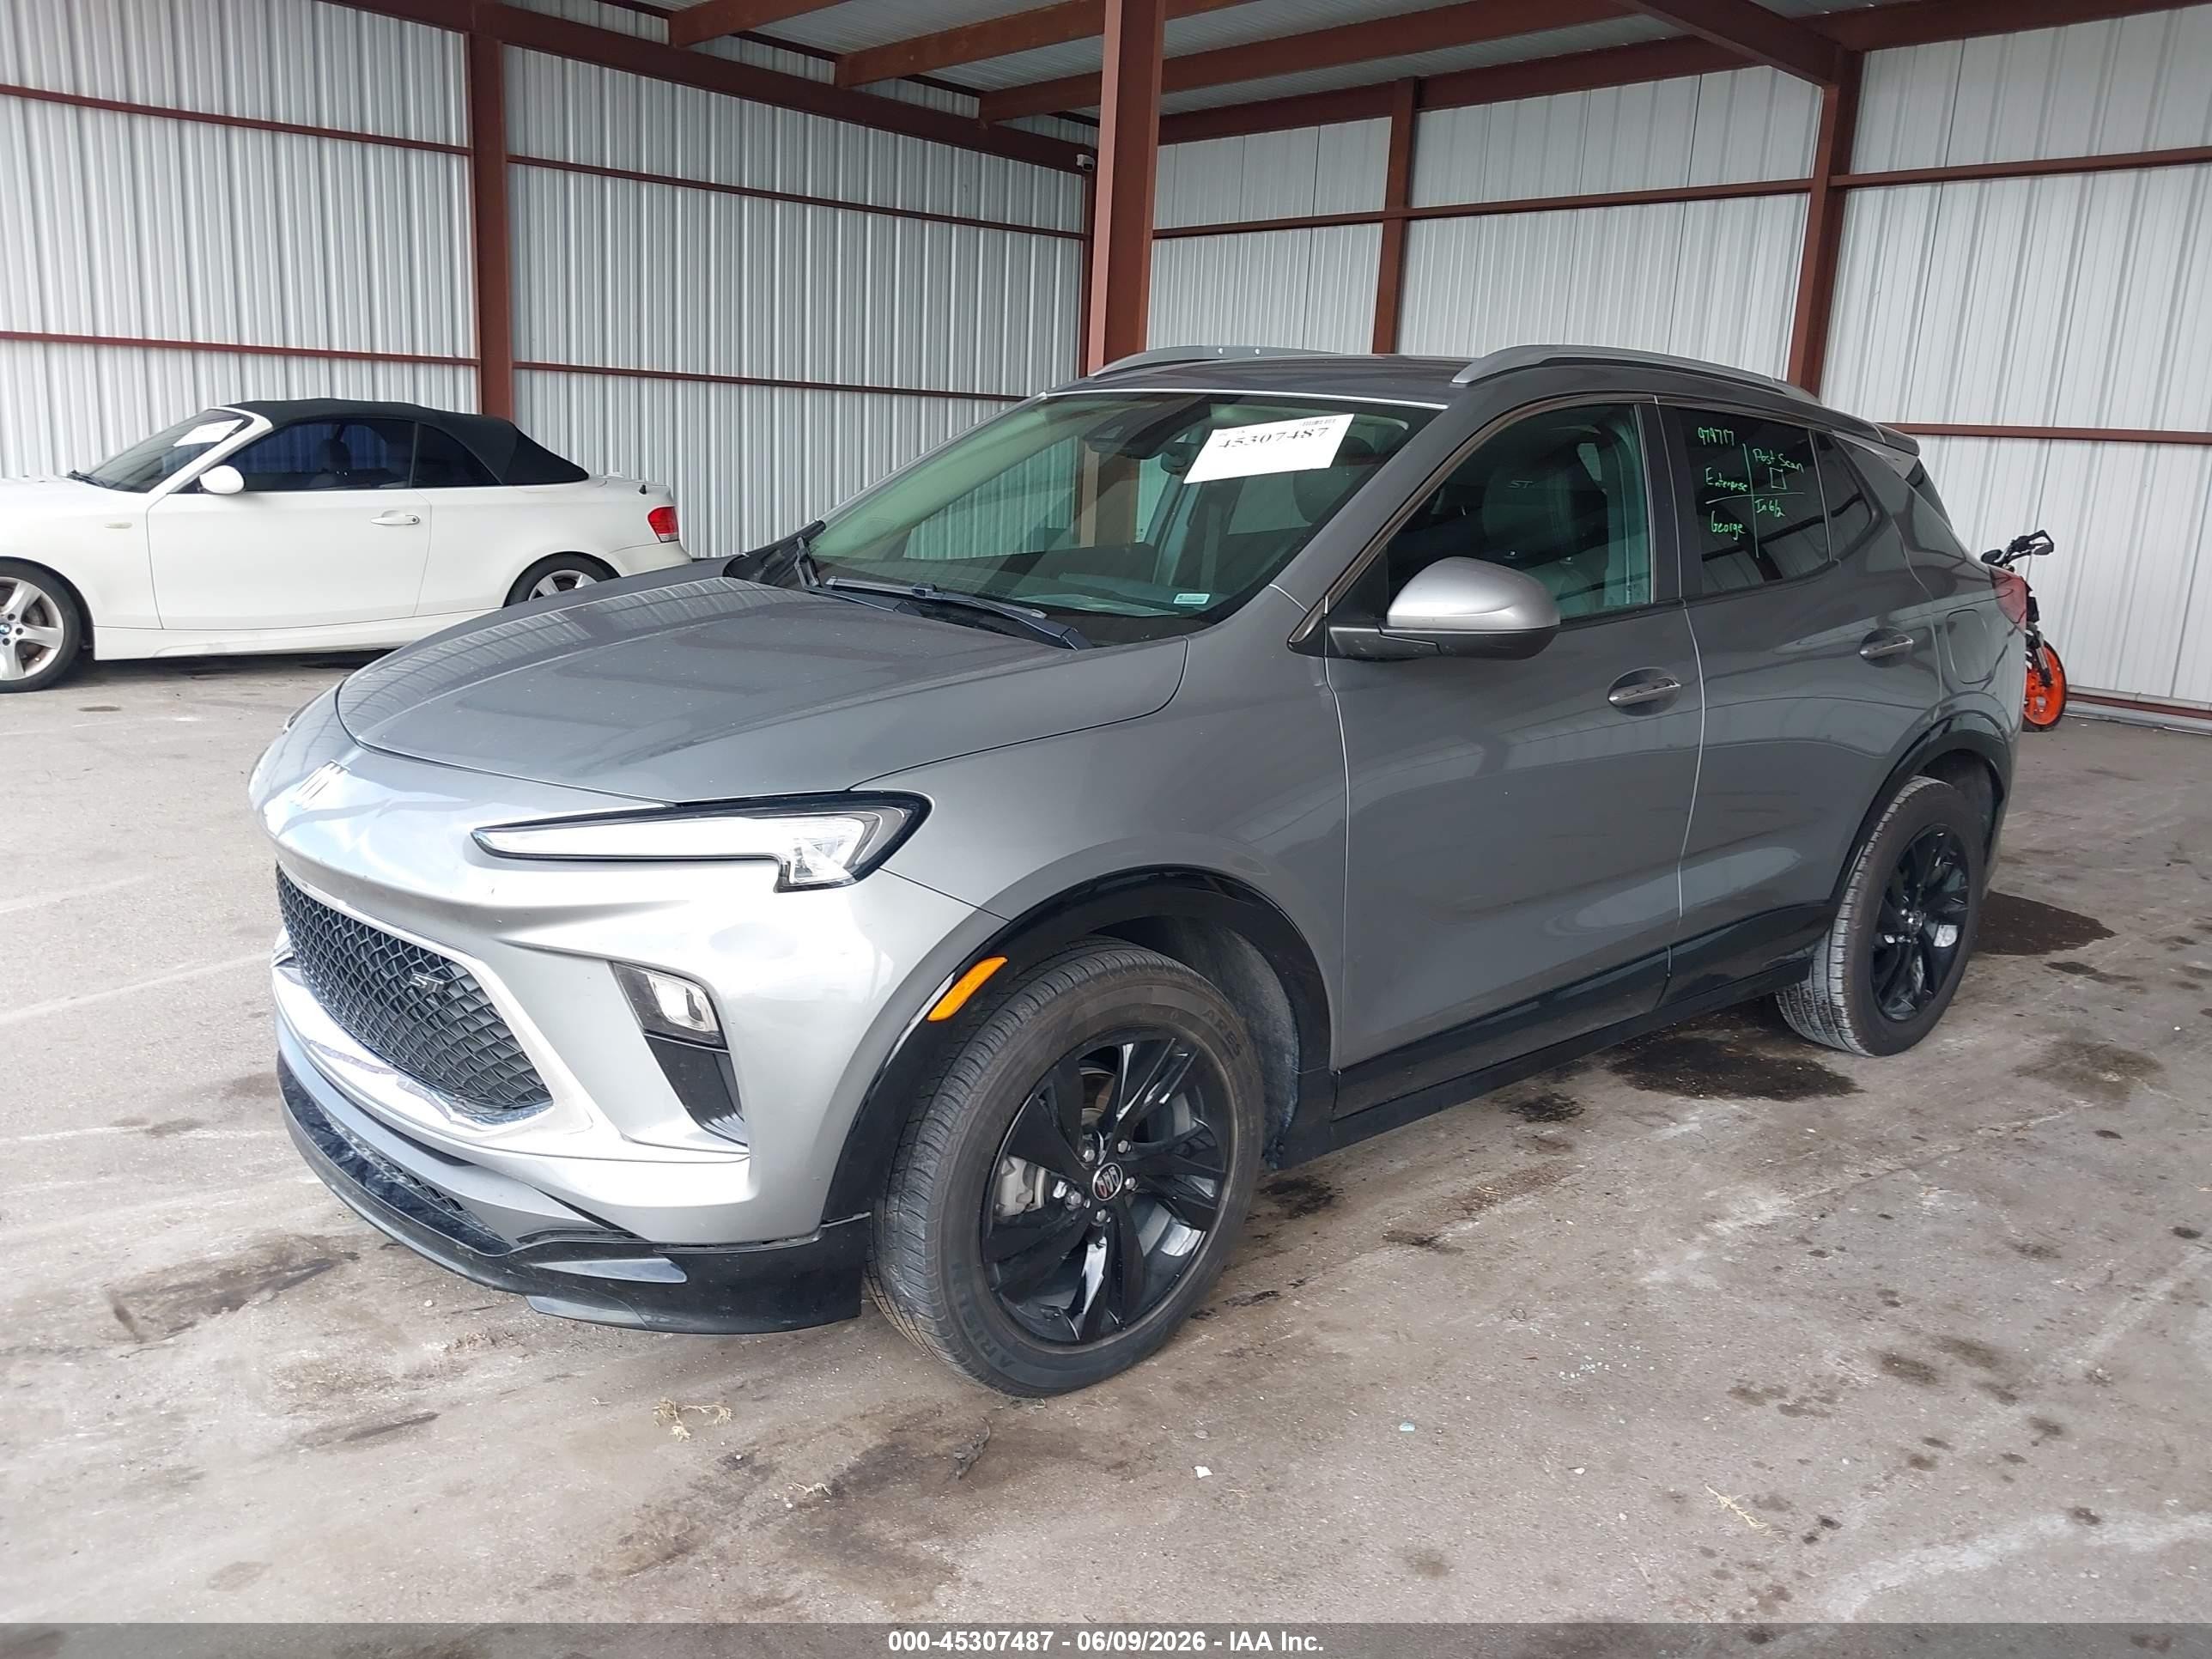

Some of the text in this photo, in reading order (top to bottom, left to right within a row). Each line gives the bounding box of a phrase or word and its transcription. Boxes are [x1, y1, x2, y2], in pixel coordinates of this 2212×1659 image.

[1218, 427, 1329, 449] 45307487
[1753, 448, 1804, 474] Post Scan
[1711, 510, 1746, 540] George
